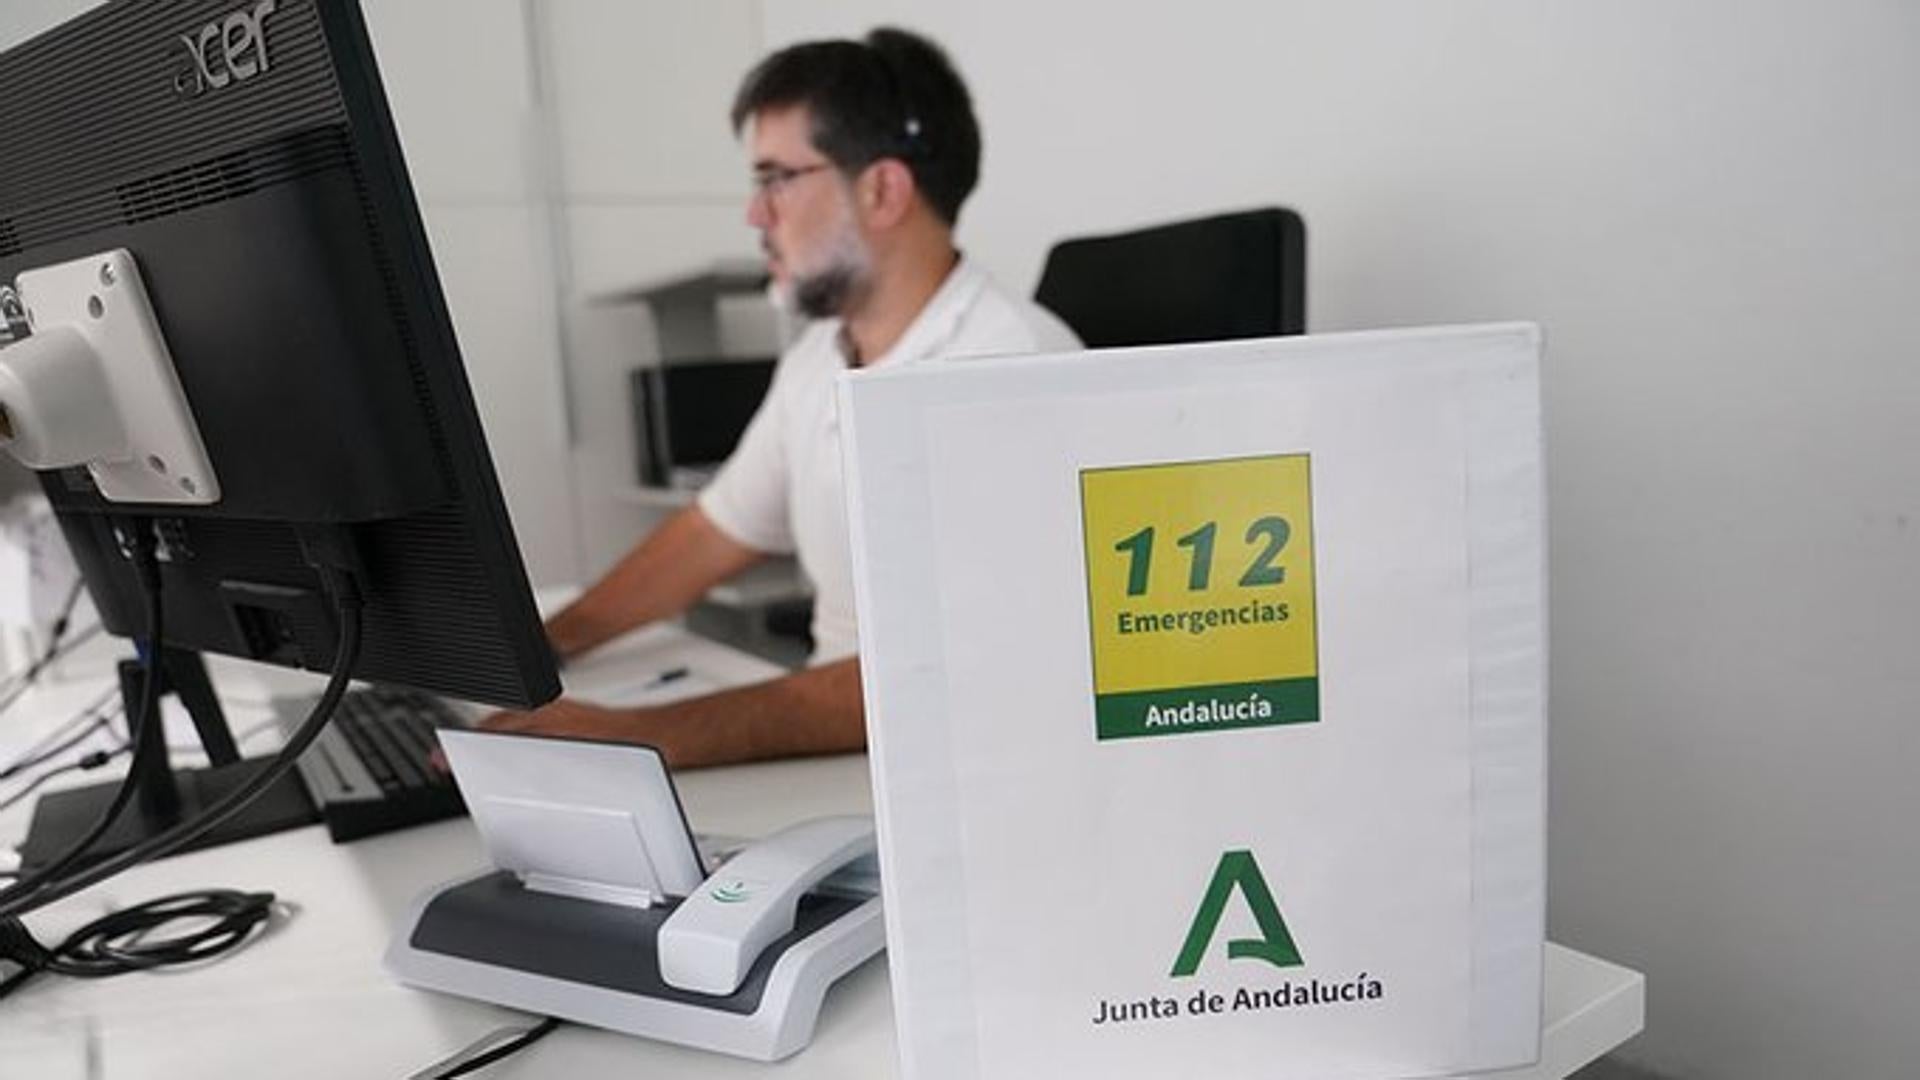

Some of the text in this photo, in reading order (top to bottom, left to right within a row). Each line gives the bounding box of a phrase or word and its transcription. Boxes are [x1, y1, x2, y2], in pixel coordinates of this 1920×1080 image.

[1114, 516, 1290, 596] 112
[1118, 600, 1289, 634] Emergencias
[1145, 693, 1272, 727] Andalucía
[1092, 973, 1382, 1024] Junta de Andalucía
